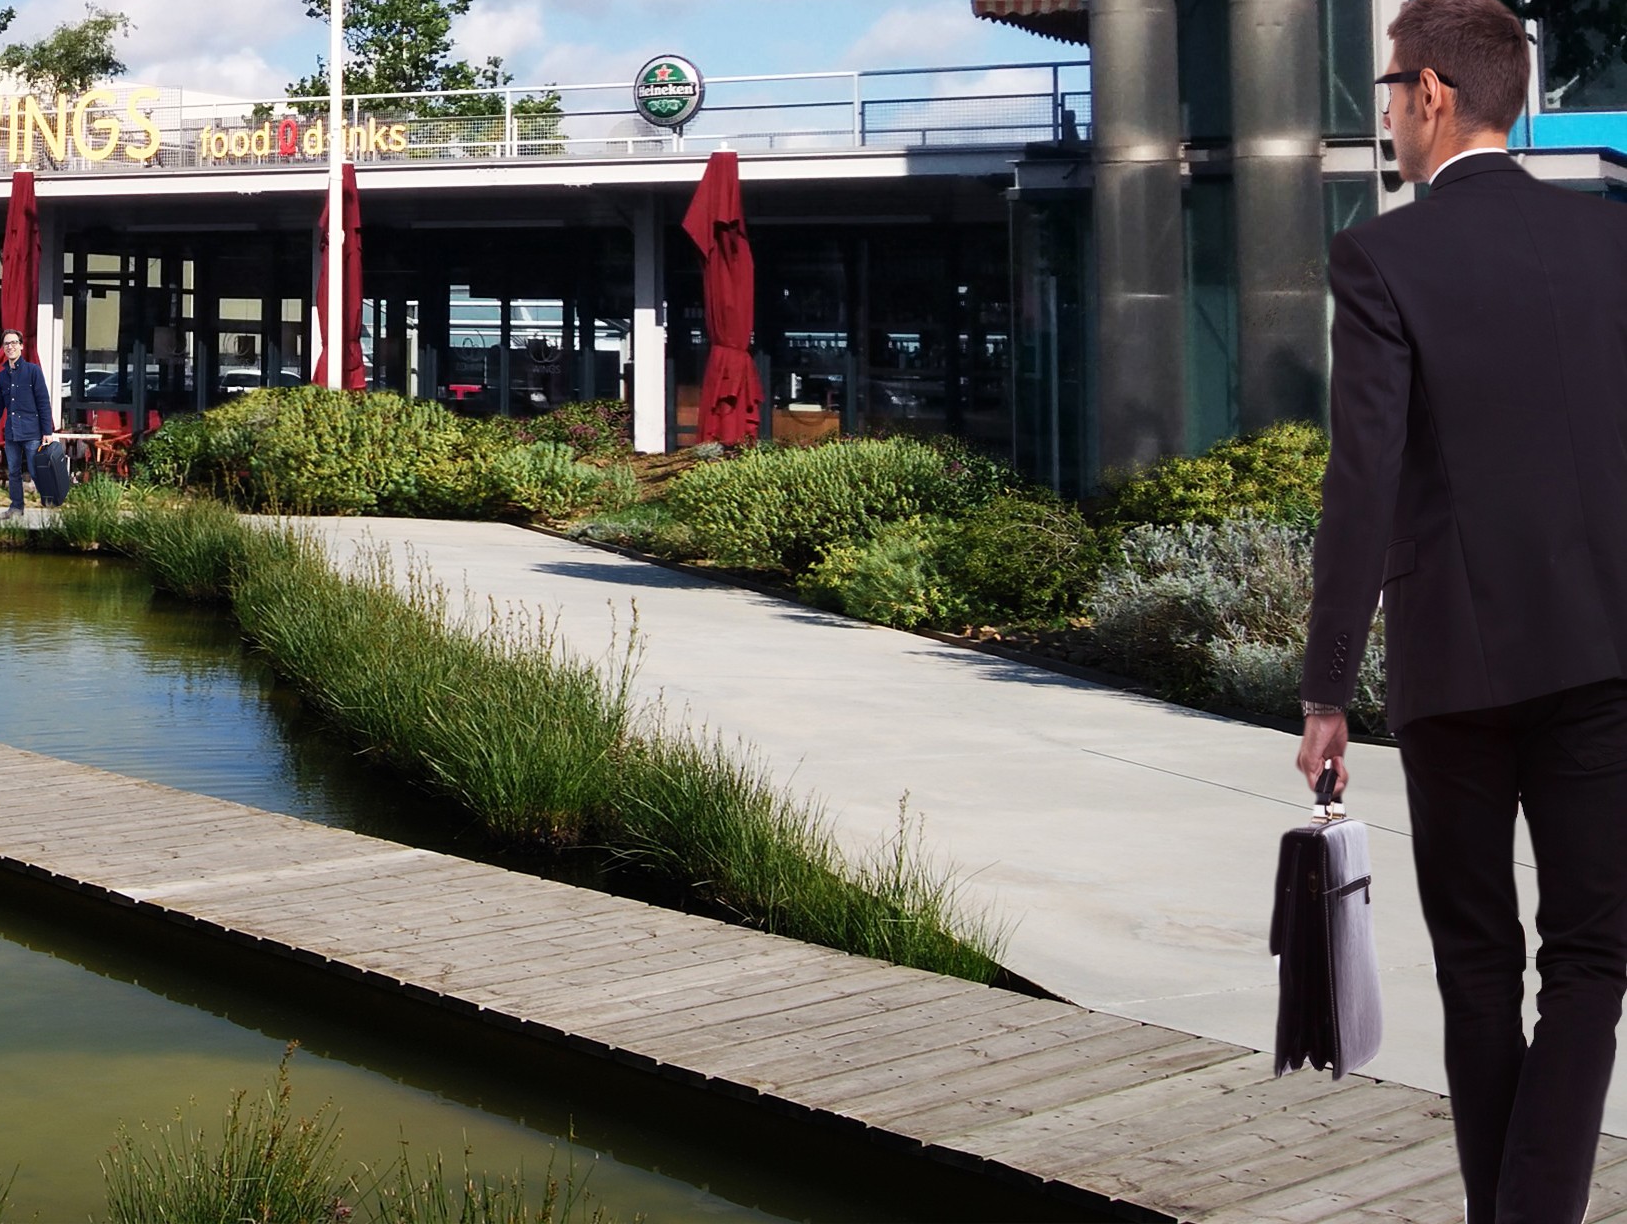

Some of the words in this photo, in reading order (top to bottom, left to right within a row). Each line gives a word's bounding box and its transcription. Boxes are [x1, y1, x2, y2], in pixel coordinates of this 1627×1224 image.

[638, 84, 694, 97] Heineken
[200, 121, 270, 158] food
[303, 117, 407, 155] dinks
